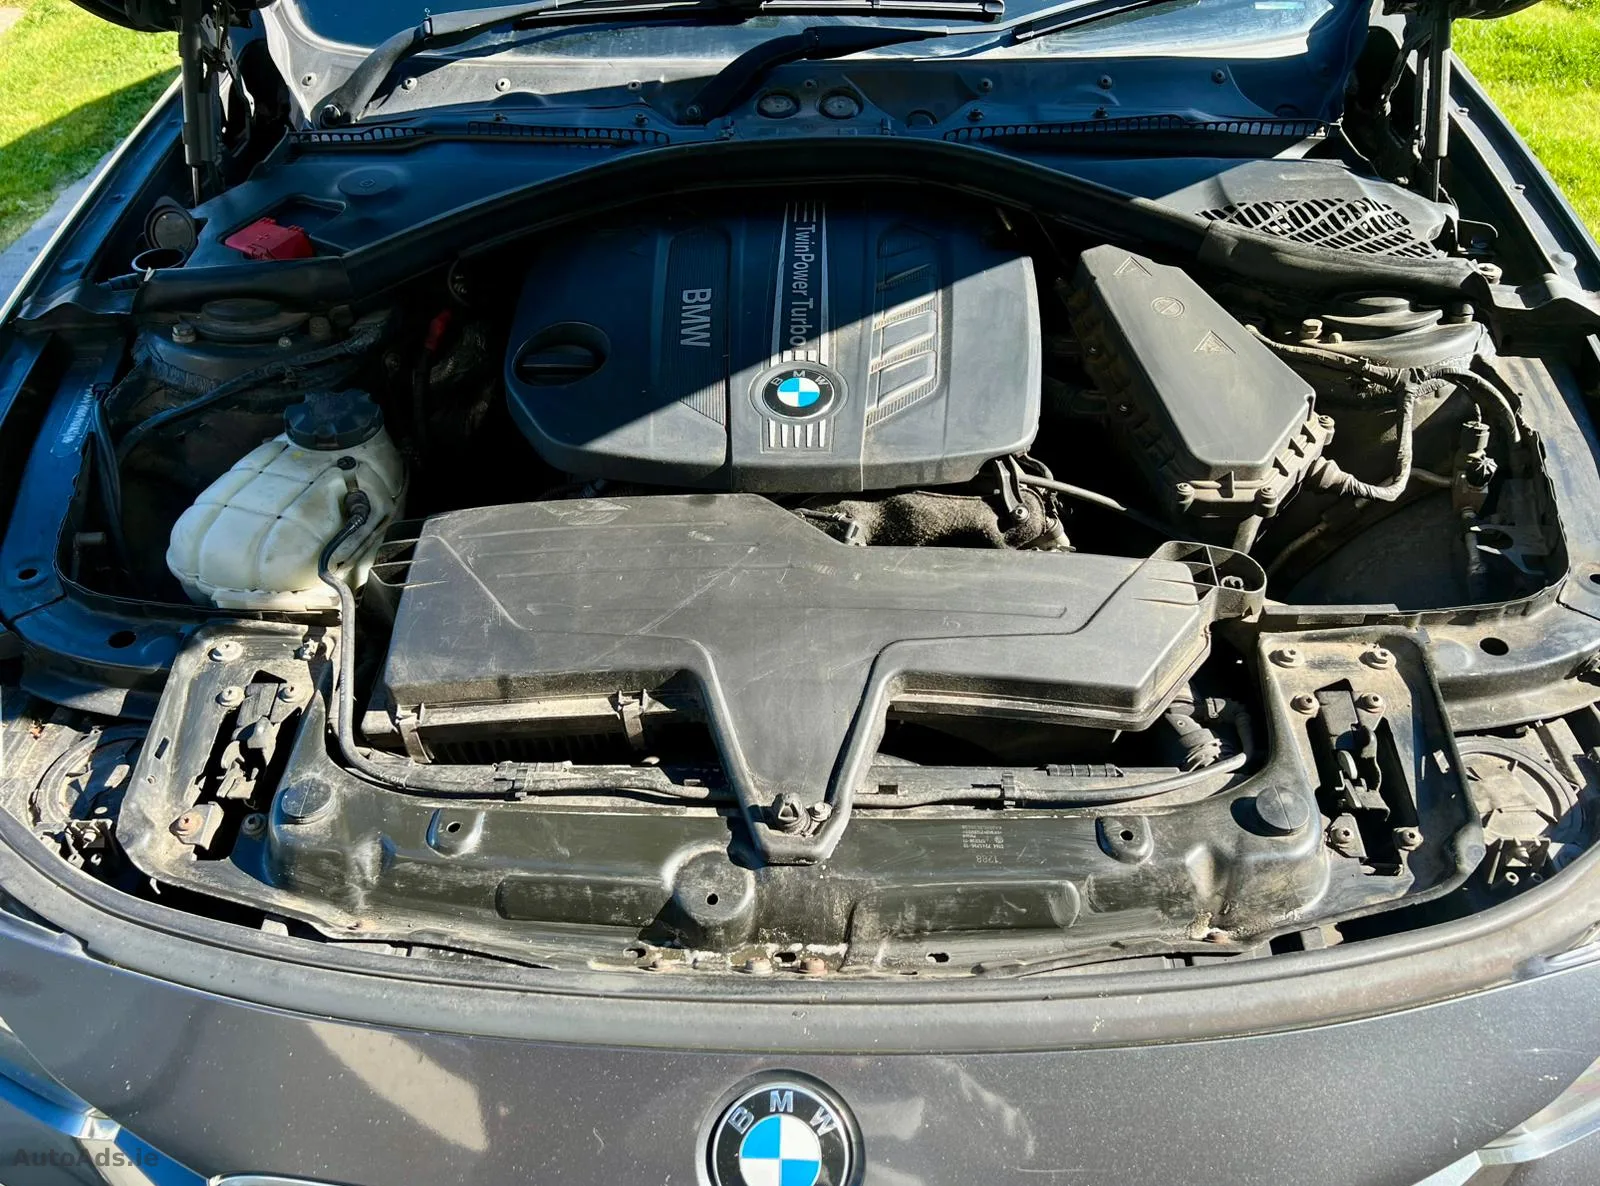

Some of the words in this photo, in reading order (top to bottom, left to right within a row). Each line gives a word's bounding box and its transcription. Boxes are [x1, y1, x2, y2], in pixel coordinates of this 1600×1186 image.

[792, 224, 816, 297] TwinPower
[680, 288, 712, 347] BMW
[789, 298, 814, 348] Turbo
[771, 370, 829, 386] BMW
[727, 1090, 838, 1136] BMW
